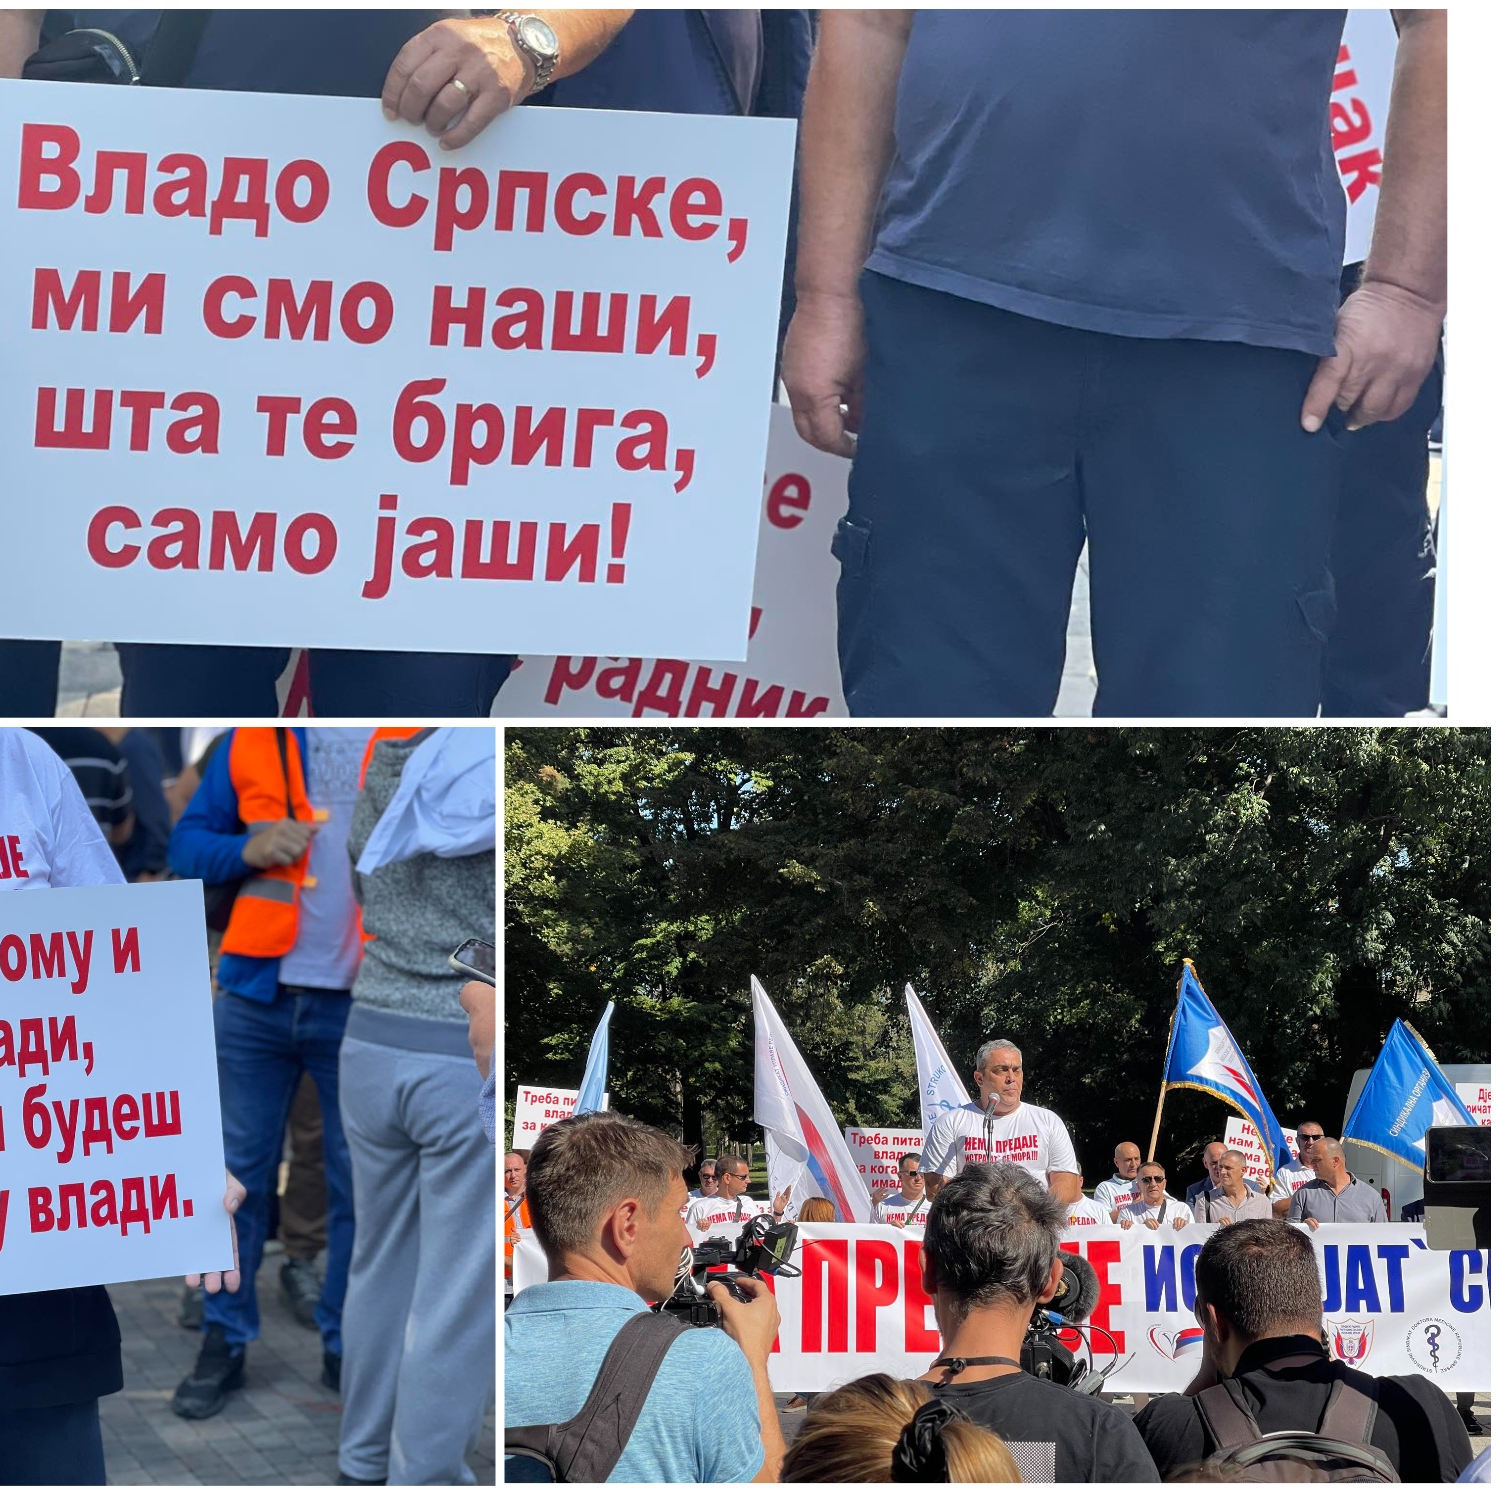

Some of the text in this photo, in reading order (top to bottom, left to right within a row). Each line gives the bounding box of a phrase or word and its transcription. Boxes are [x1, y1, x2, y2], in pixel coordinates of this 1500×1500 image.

[20, 125, 747, 262] Владо Српске,
[34, 269, 716, 383] ми смо наши,
[36, 374, 699, 490] шта те брига,
[89, 495, 630, 598] само јаши!
[112, 928, 140, 972] и
[523, 1091, 560, 1106] Треба
[1389, 1067, 1431, 1137] СИНДИКАЛНА ОРГАНИЗ
[24, 1084, 181, 1163] будеш
[522, 1121, 536, 1131] за
[851, 1132, 888, 1147] Треба
[995, 1135, 1038, 1153] ПРЕДАЈЕ
[1228, 1136, 1254, 1149] нам
[873, 1150, 908, 1163] влад
[1011, 1151, 1038, 1162] МОРА!!!
[29, 1175, 193, 1236] влади.
[1114, 1193, 1132, 1204] НЕМА
[802, 1239, 1126, 1354] ПРЕЕ
